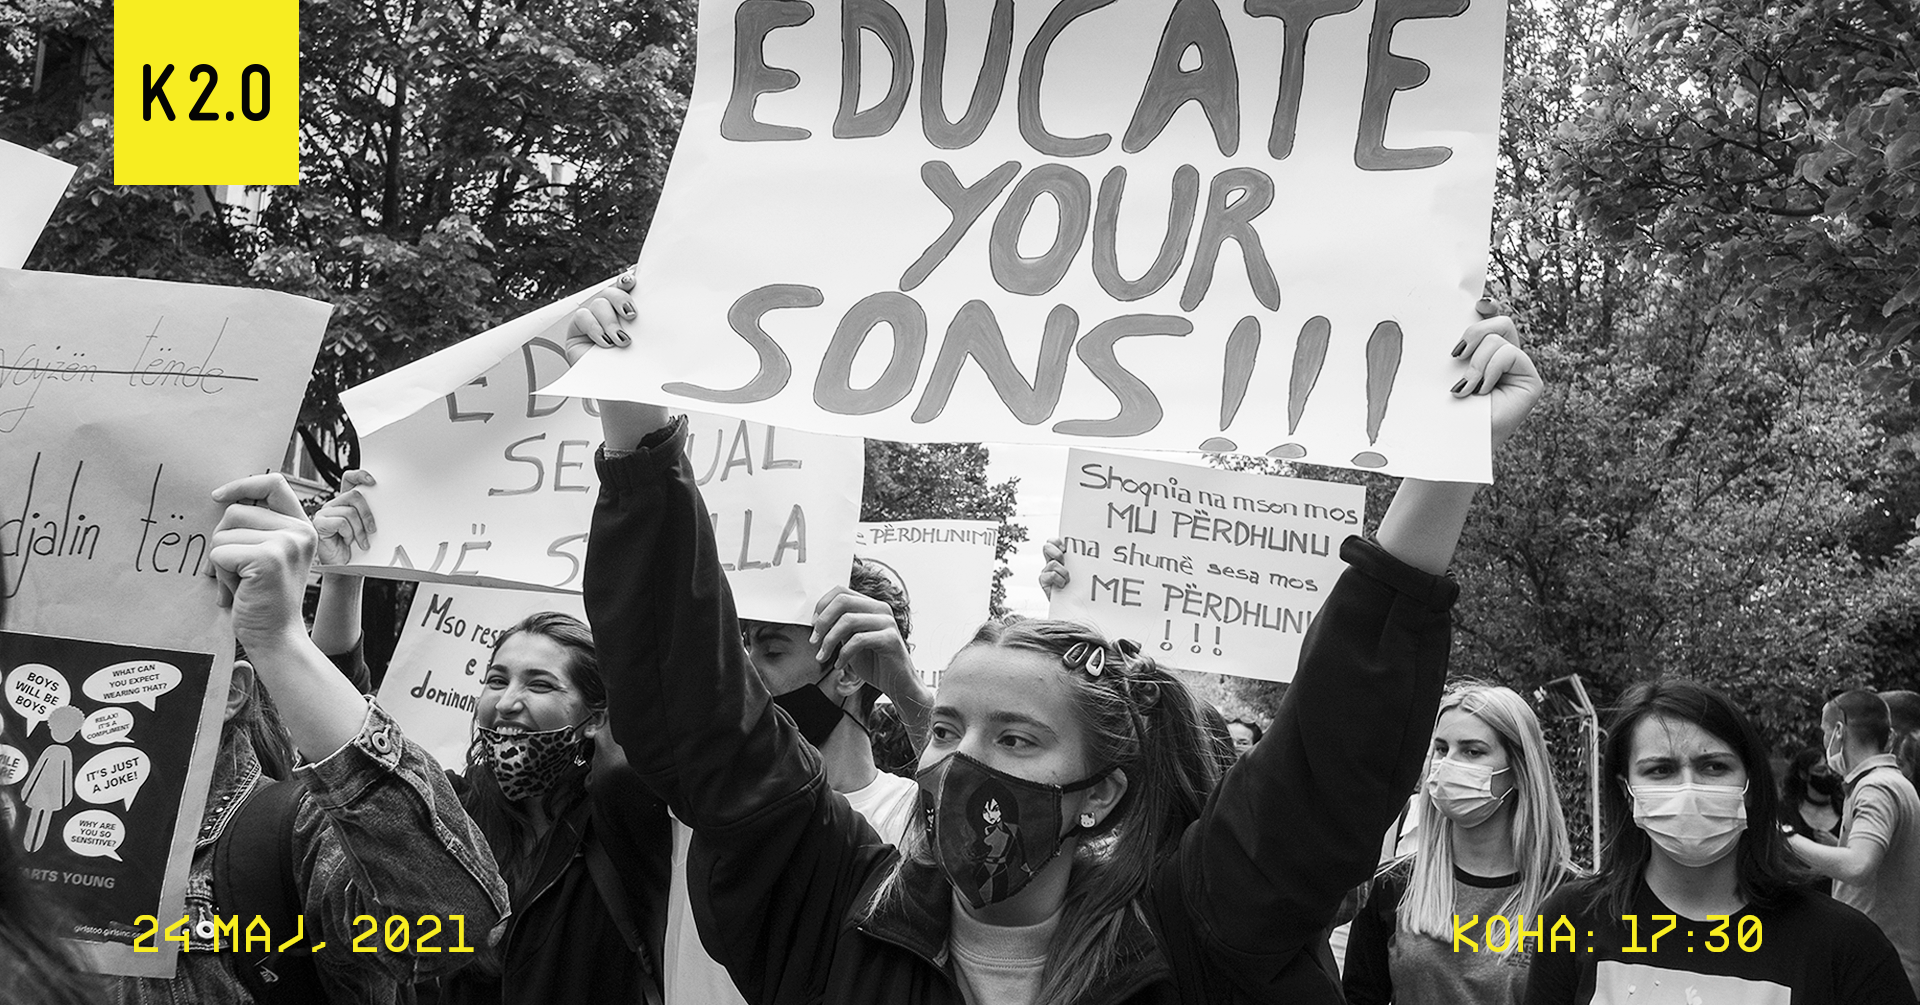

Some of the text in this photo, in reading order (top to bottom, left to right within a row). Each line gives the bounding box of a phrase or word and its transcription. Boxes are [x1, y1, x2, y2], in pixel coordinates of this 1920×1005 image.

[720, 0, 1473, 171] EDUCATE
[900, 160, 1280, 312] YOUR
[129, 315, 225, 394] tënde
[662, 283, 1404, 467] SONS!!!
[1080, 463, 1358, 525] Shoqnia na mson mos
[0, 452, 101, 598] djalin
[1107, 502, 1330, 557] MU PËRDHUNU
[1064, 535, 1318, 592] ma shumë sesa mos
[1091, 574, 1144, 607] ME
[421, 593, 466, 638] Mso
[27, 672, 59, 692] BOYS
[109, 674, 160, 689] YOU EXPECT
[112, 664, 156, 678] WHAT CAN
[15, 681, 60, 706] WILL BE
[103, 683, 168, 700] WEARING THAT?
[410, 670, 479, 713] dominan
[15, 695, 47, 715] BOYS
[86, 723, 130, 740] COMPLIMENT
[86, 757, 140, 782] IT'S JUST
[92, 771, 138, 794] A JOKE!
[79, 820, 116, 831] WHY ARE
[80, 828, 112, 838] YOU SO
[71, 835, 117, 847] SENSITIVE?
[63, 872, 116, 889] YOUNG
